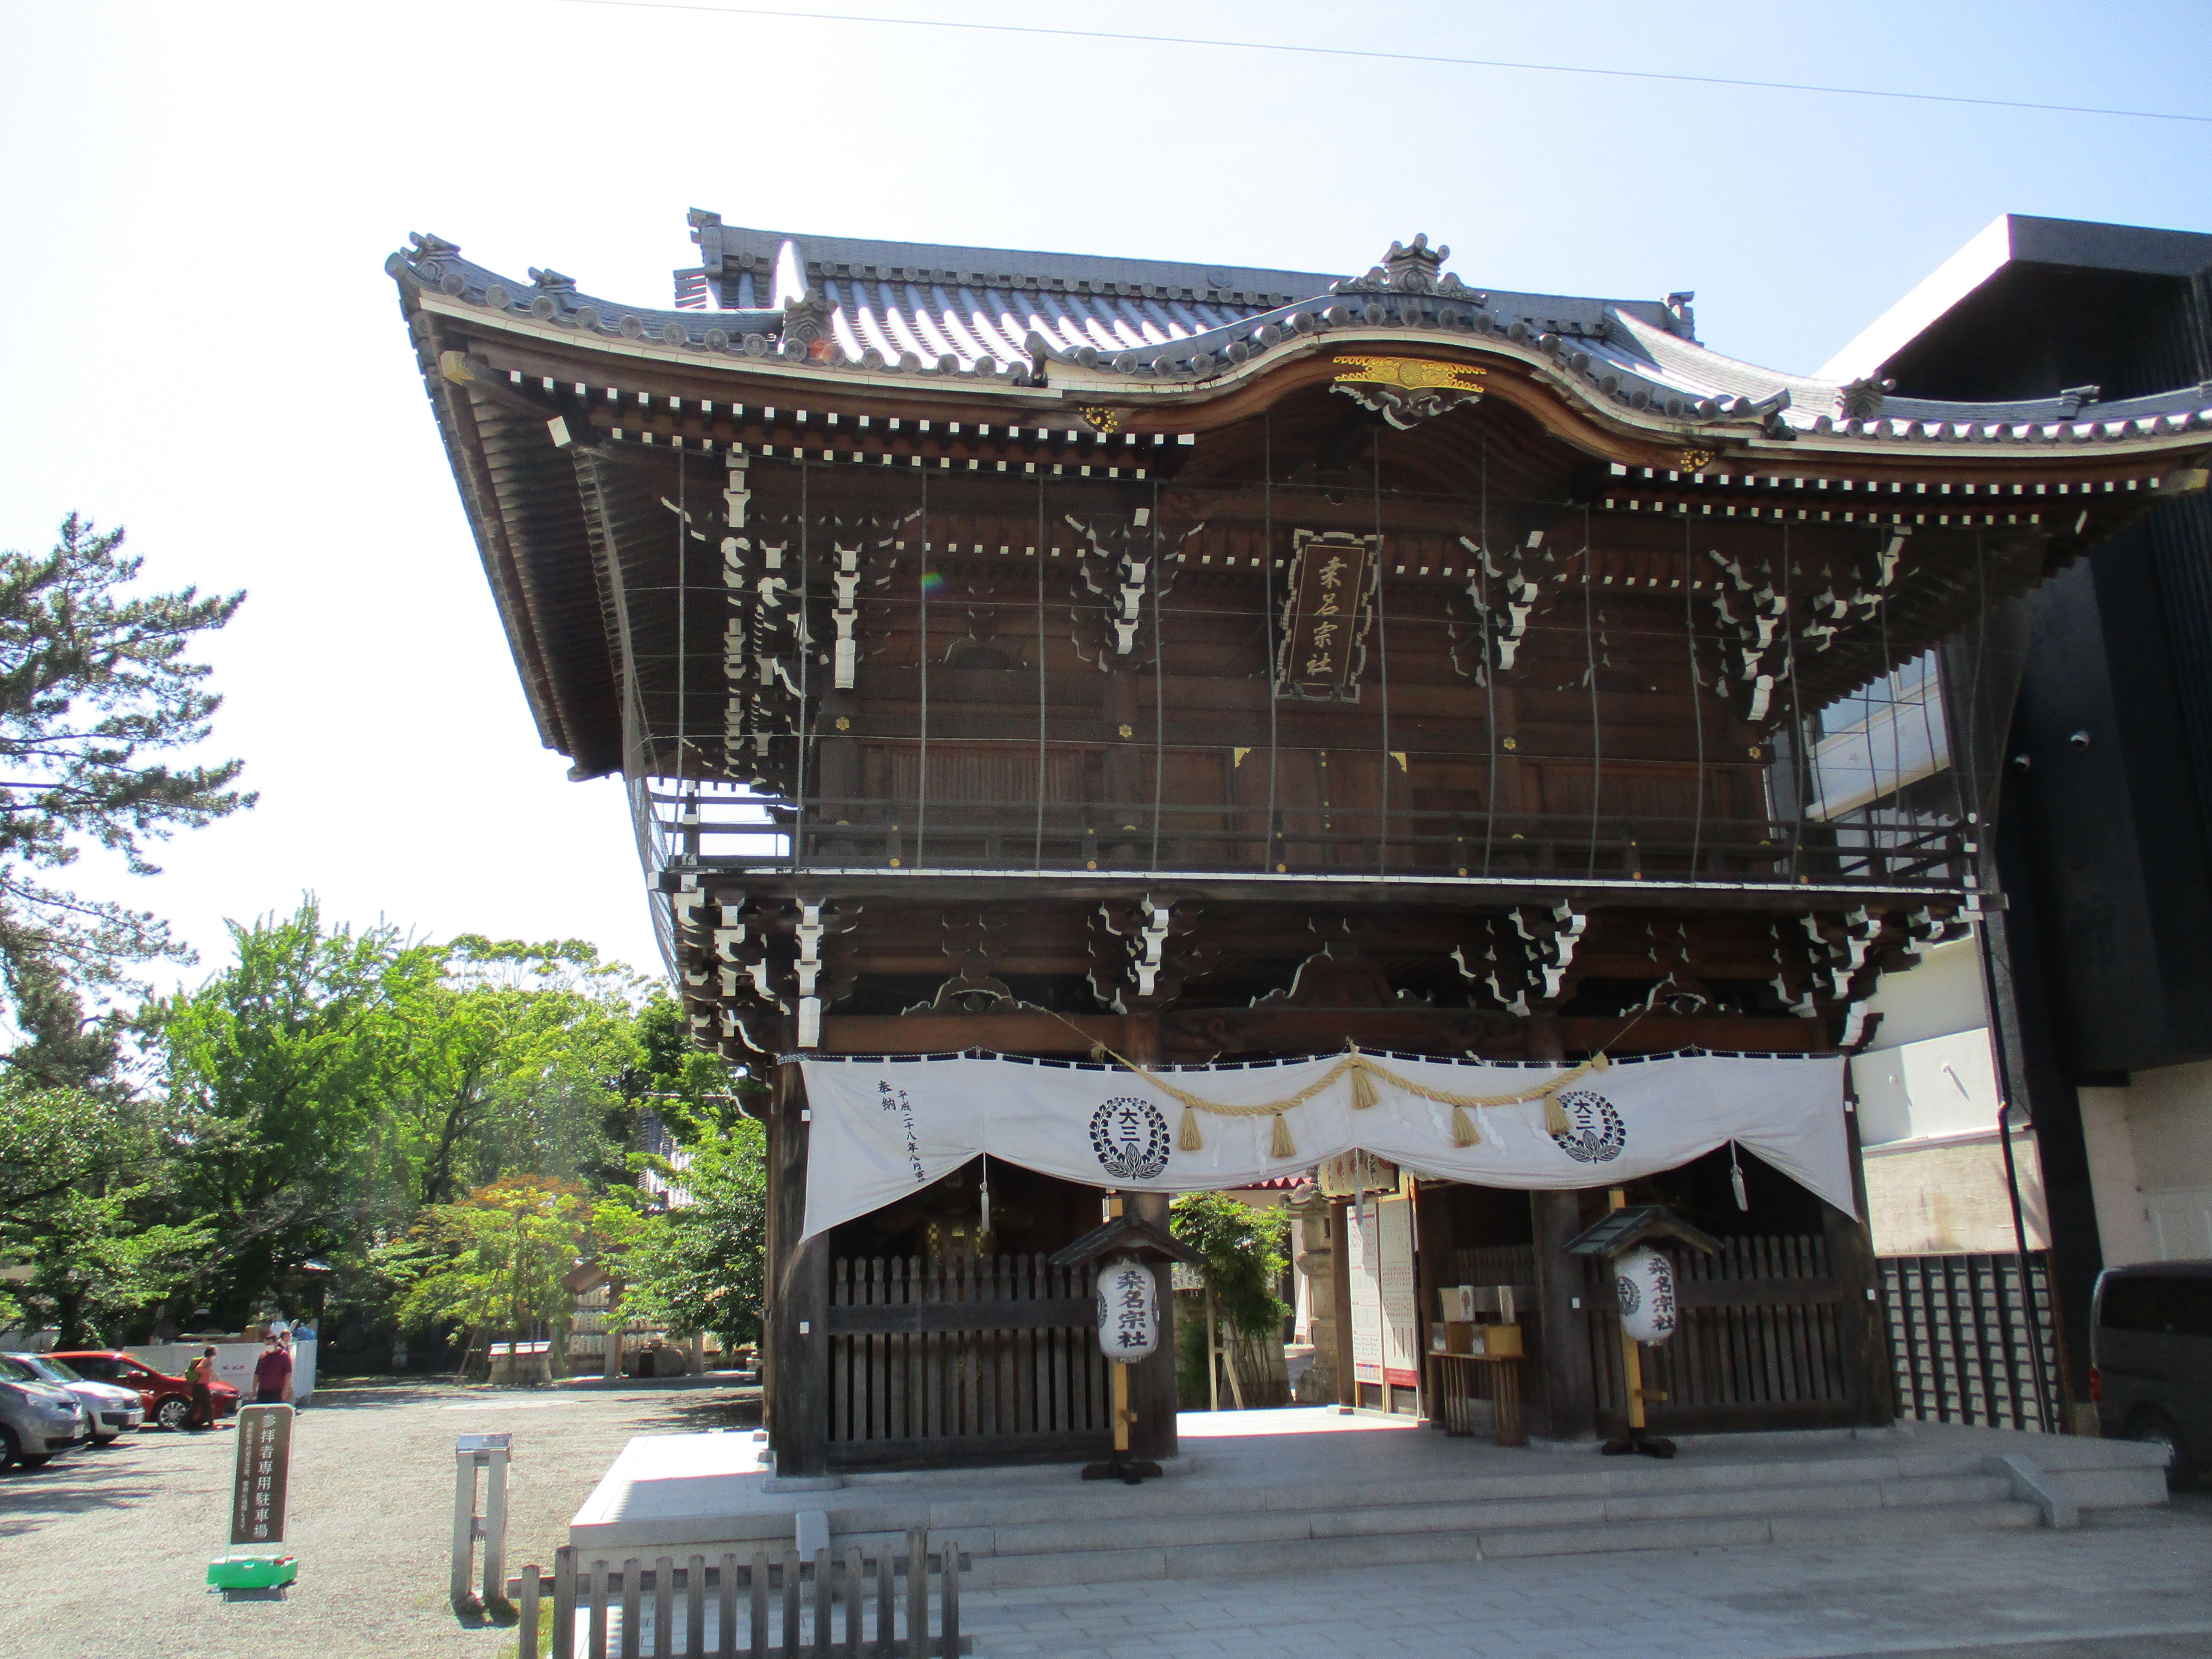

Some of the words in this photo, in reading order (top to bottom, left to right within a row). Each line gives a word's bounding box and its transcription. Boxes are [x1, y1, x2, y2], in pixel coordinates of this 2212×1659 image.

[878, 1080, 896, 1111] 奉納
[1115, 1270, 1148, 1349] 桑名宗社
[1647, 1257, 1675, 1331] 桑名宗社
[253, 1413, 276, 1539] 参拝者専用駐車場
